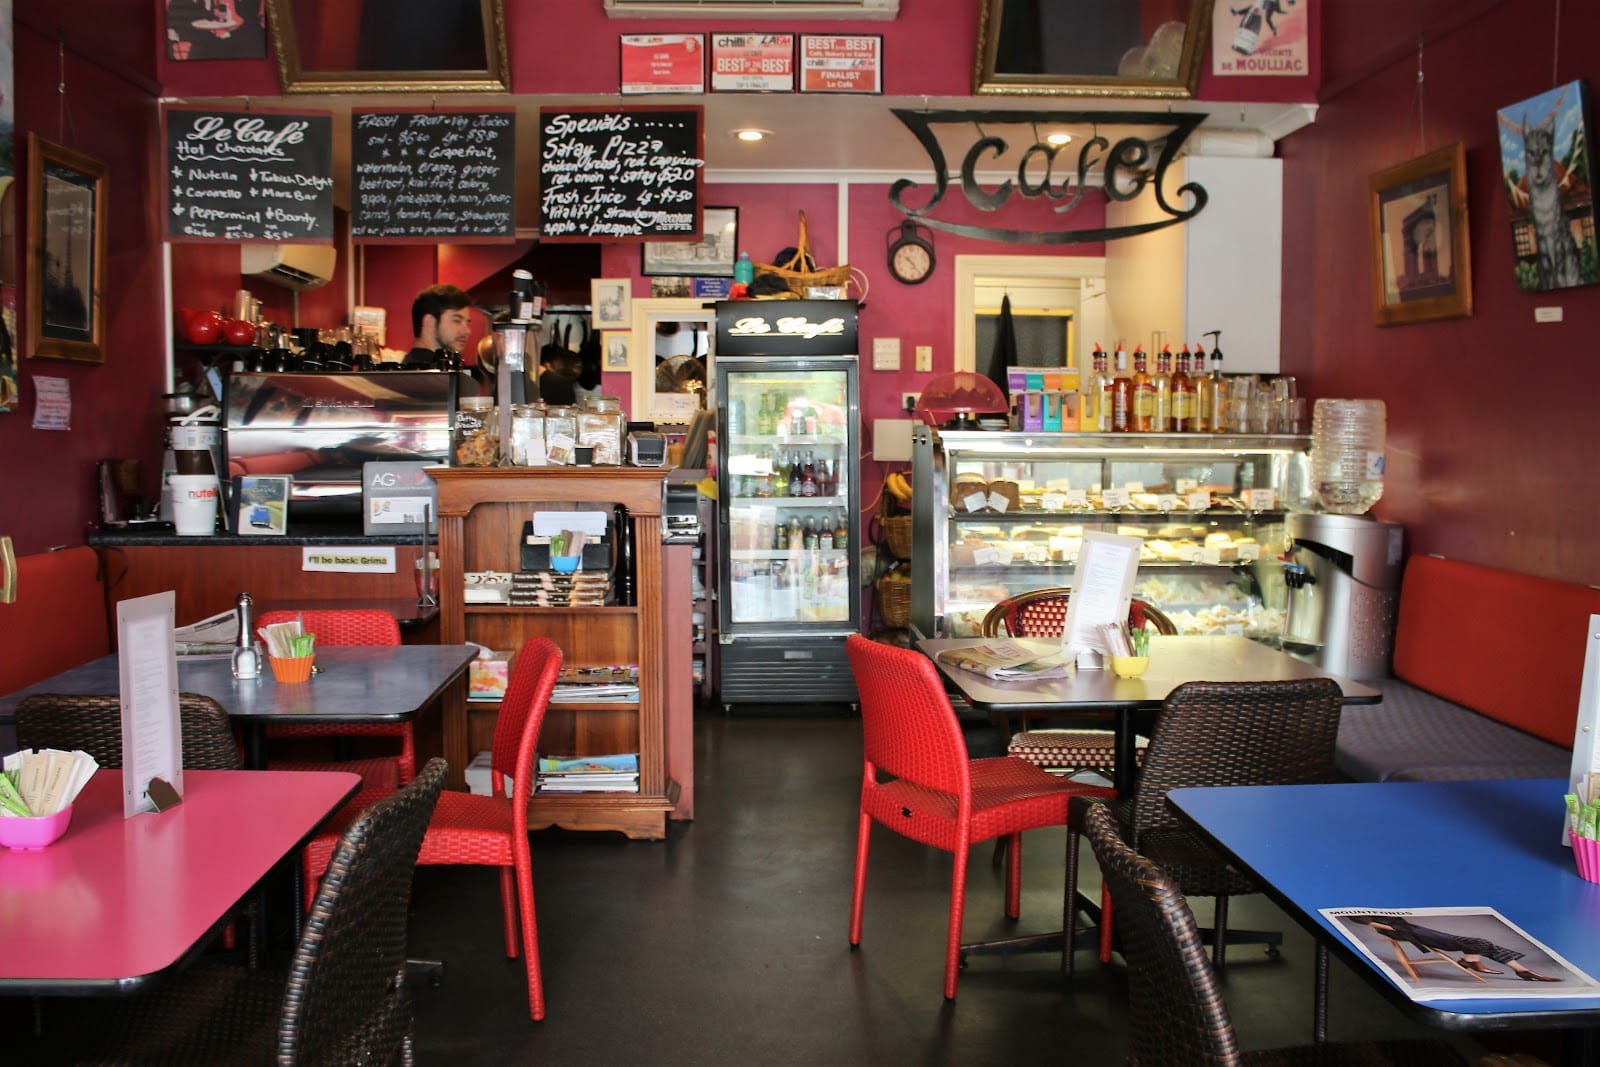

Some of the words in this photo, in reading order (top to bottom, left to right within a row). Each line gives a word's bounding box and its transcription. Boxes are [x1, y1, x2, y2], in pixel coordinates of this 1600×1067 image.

[807, 38, 837, 49] BEST
[846, 39, 875, 51] BEST
[717, 58, 746, 73] BEST
[761, 59, 791, 73] BEST
[821, 72, 861, 80] FINALIST
[358, 114, 400, 129] FRESH
[186, 117, 232, 141] Le
[233, 118, 309, 152] Café
[176, 140, 204, 156] Hot
[543, 137, 597, 163] Satay
[623, 156, 647, 168] red
[188, 168, 239, 182] Nutella
[551, 174, 573, 186] red
[574, 173, 605, 184] onion
[657, 166, 695, 188] $20
[294, 190, 318, 202] Bar
[542, 184, 579, 206] Fresh
[189, 205, 261, 223] Peppermint
[321, 556, 333, 564] be
